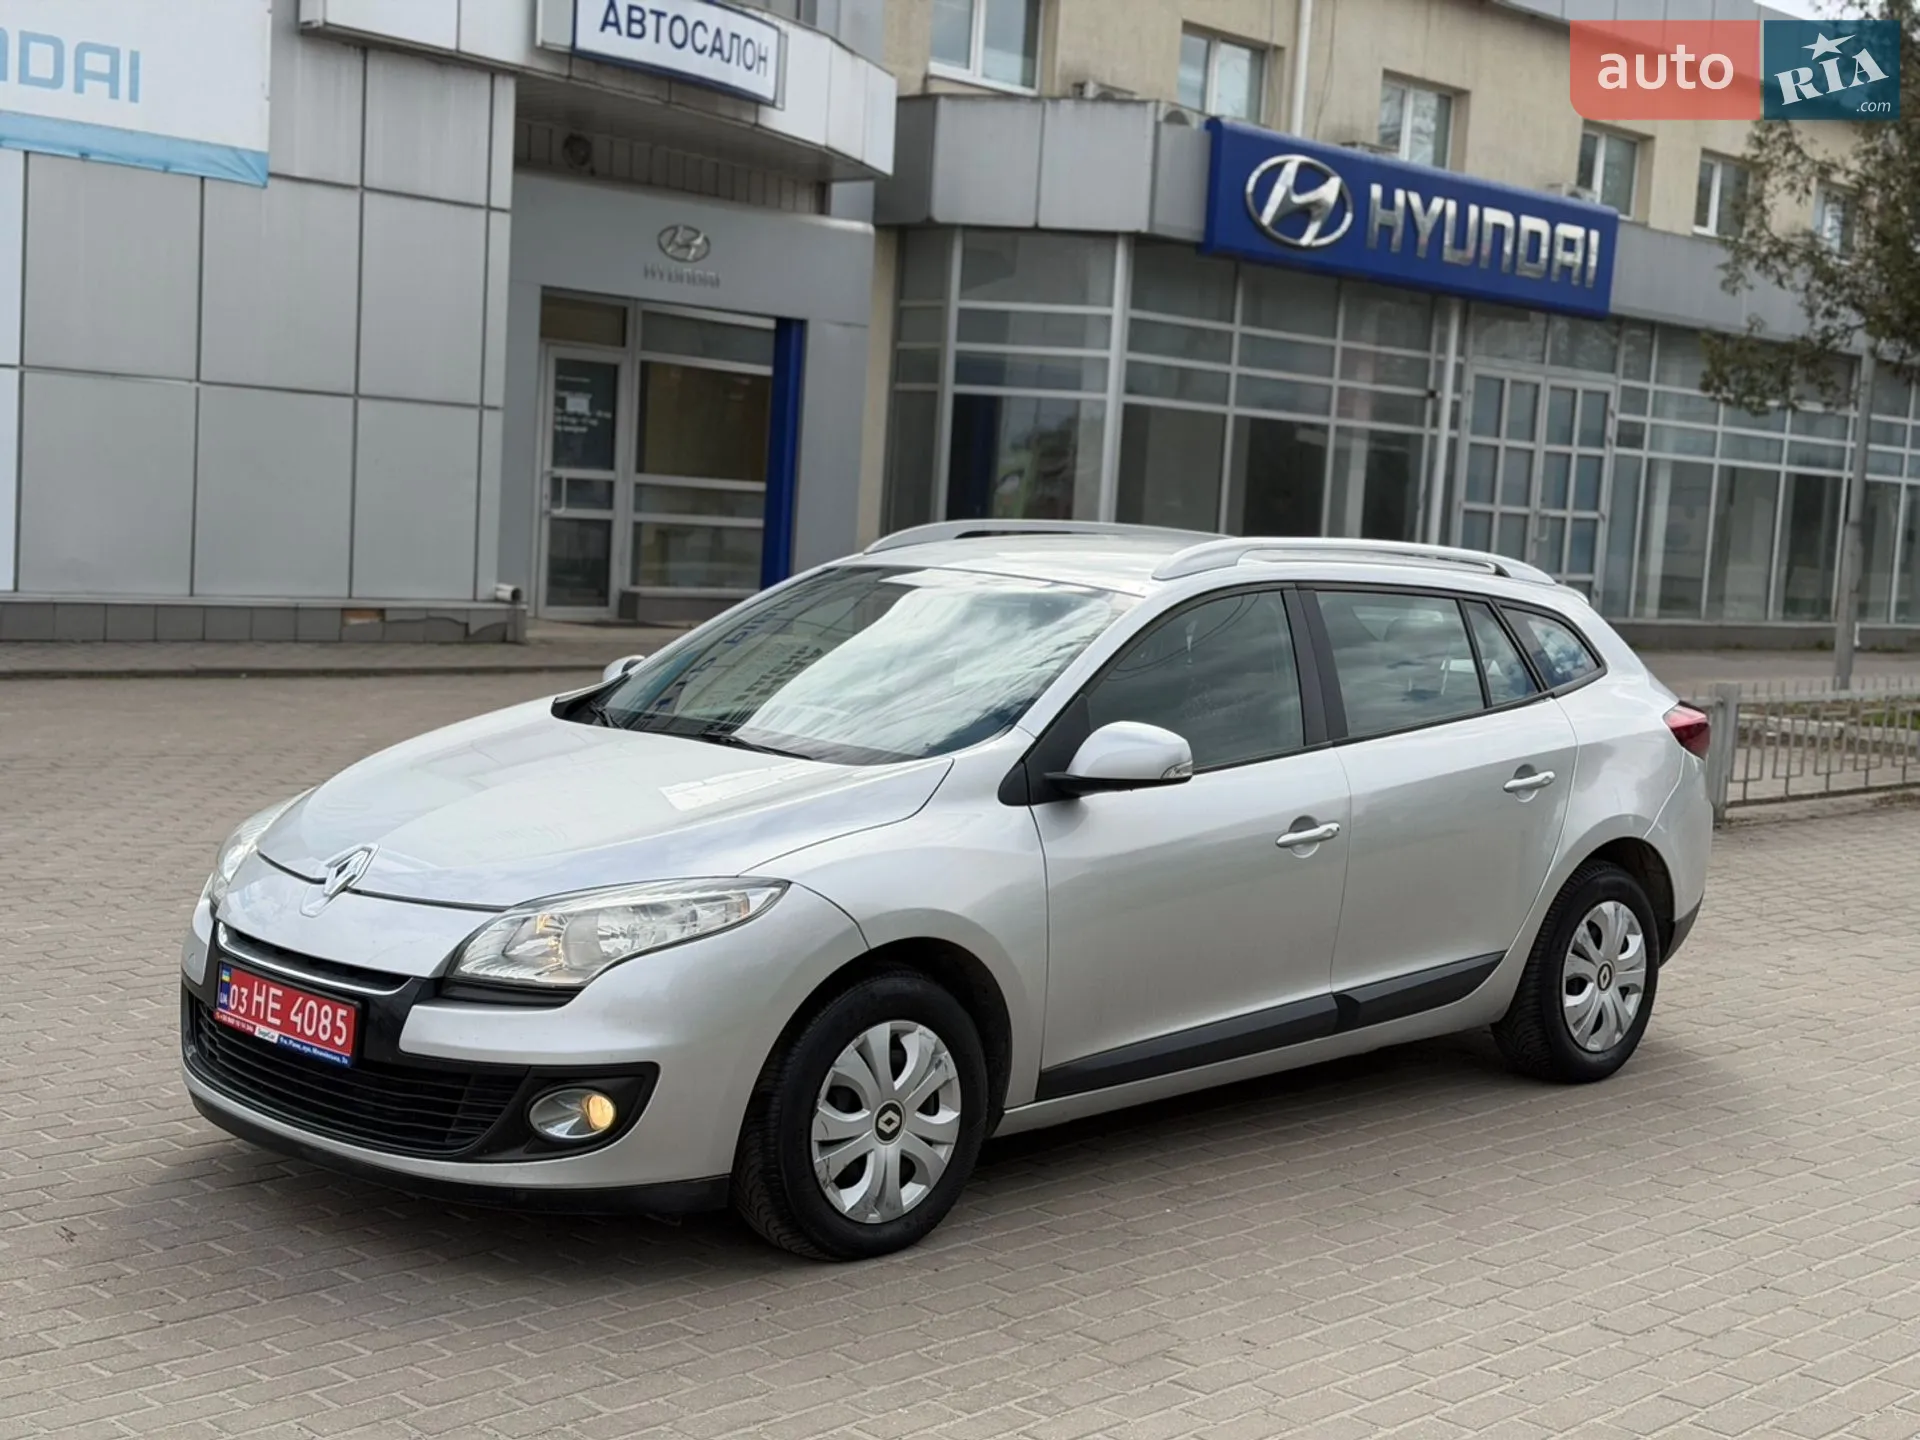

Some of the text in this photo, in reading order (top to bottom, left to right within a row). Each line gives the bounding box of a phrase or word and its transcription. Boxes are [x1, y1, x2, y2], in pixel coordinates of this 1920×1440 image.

[0, 27, 141, 103] DAI
[600, 0, 769, 78] АВТОСАЛОН
[1366, 182, 1601, 289] HYUNDAI
[229, 984, 248, 1014] 03
[251, 981, 283, 1026] HE
[290, 996, 347, 1046] 4085
